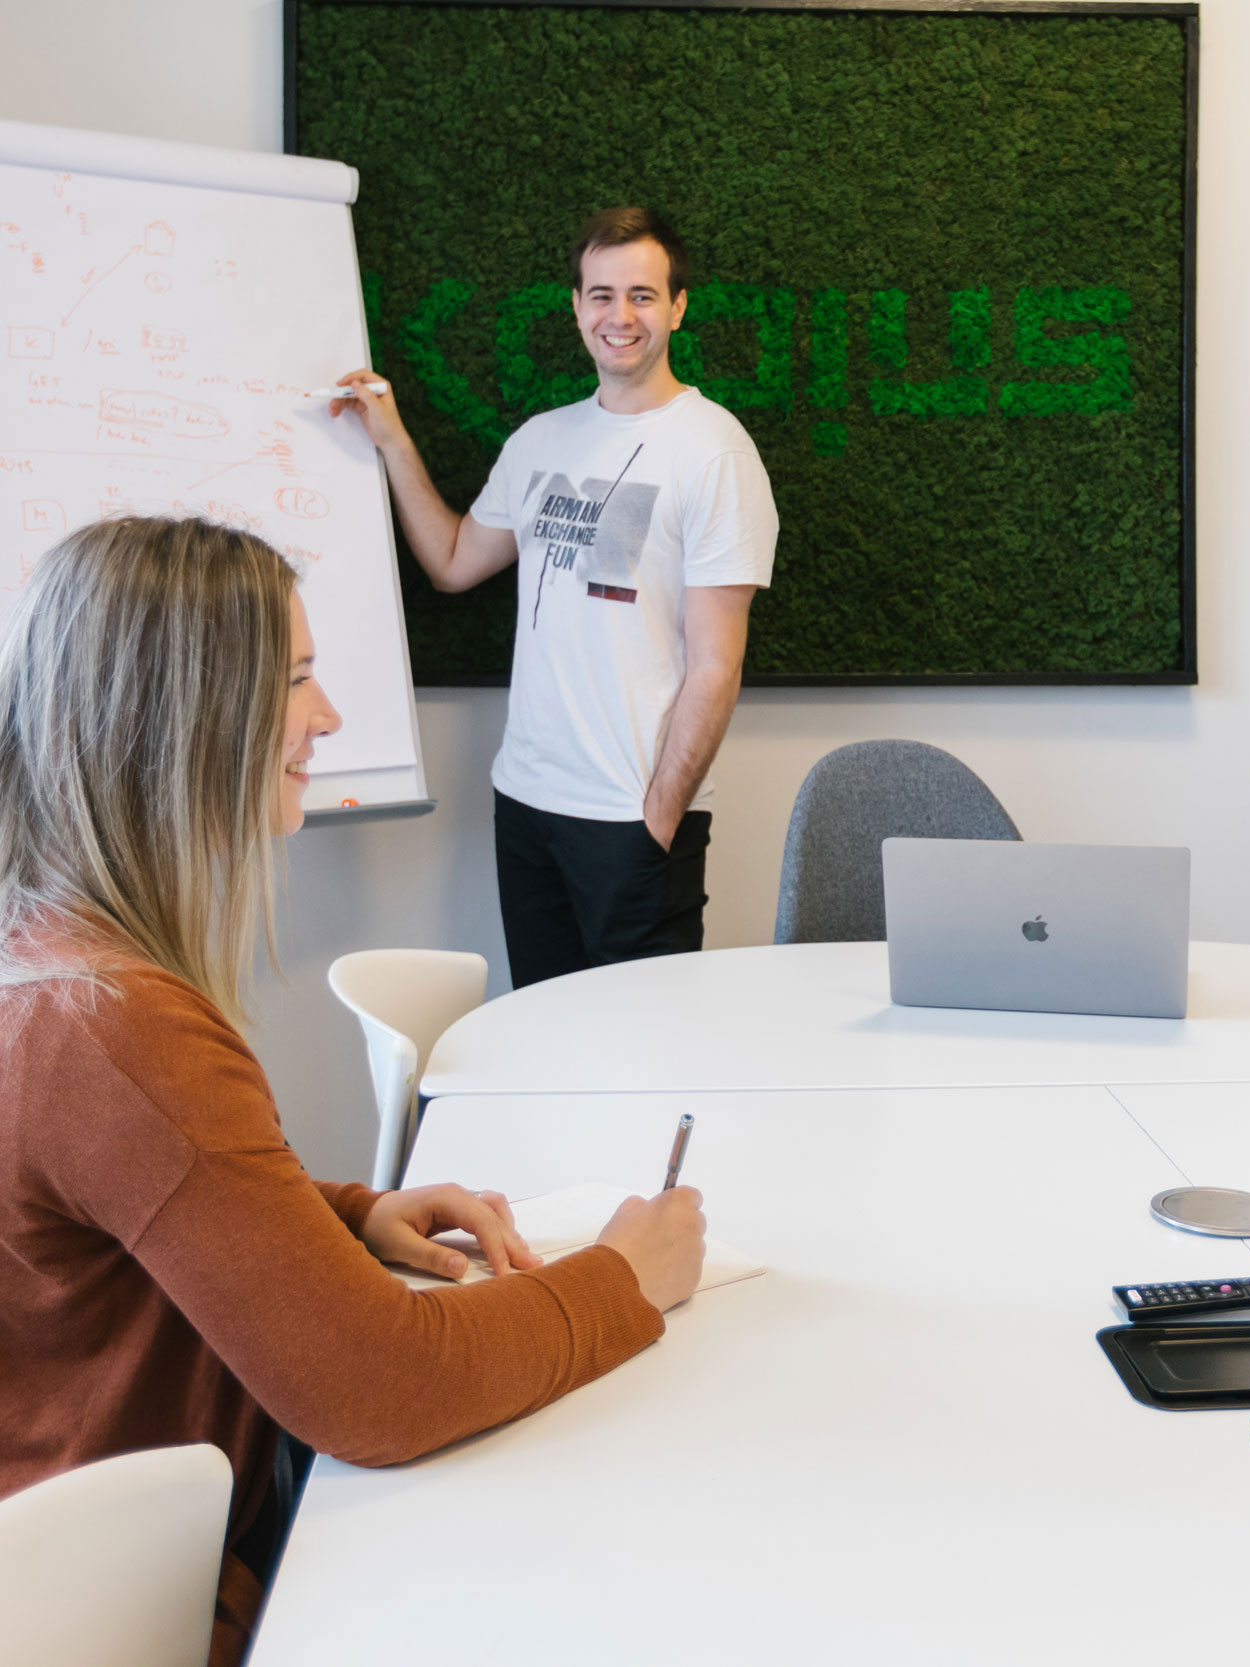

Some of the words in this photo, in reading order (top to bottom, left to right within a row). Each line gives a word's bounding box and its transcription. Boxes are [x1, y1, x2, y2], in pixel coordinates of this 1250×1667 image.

[540, 494, 603, 524] ARMANI
[534, 519, 598, 547] EXCHANGE
[547, 543, 579, 571] FUN
